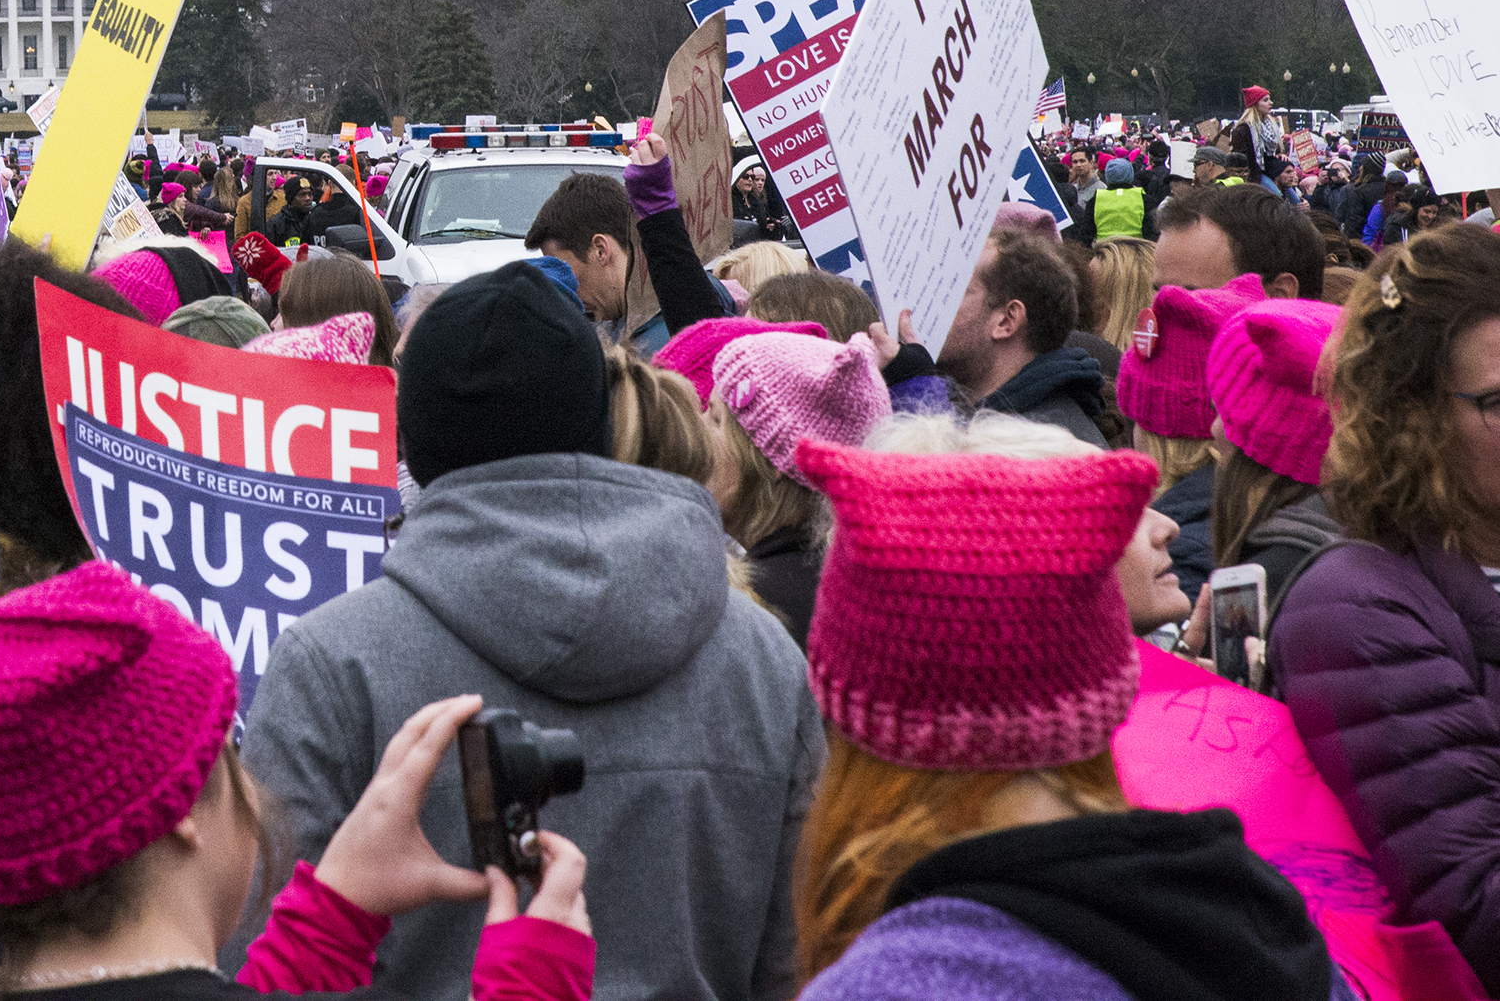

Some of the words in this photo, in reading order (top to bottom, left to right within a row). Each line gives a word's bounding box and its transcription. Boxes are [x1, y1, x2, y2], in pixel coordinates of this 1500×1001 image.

[764, 42, 827, 89] LOVE
[757, 104, 787, 129] NO
[1363, 116, 1369, 125] I
[1446, 110, 1466, 148] all
[947, 113, 992, 230] FOR
[57, 336, 380, 484] JUSTICE
[78, 423, 191, 482] REPRODUCTIVE
[197, 470, 284, 505] FREEDOM
[294, 491, 333, 512] FOR
[341, 498, 377, 516] ALL
[77, 457, 396, 600] TRUST
